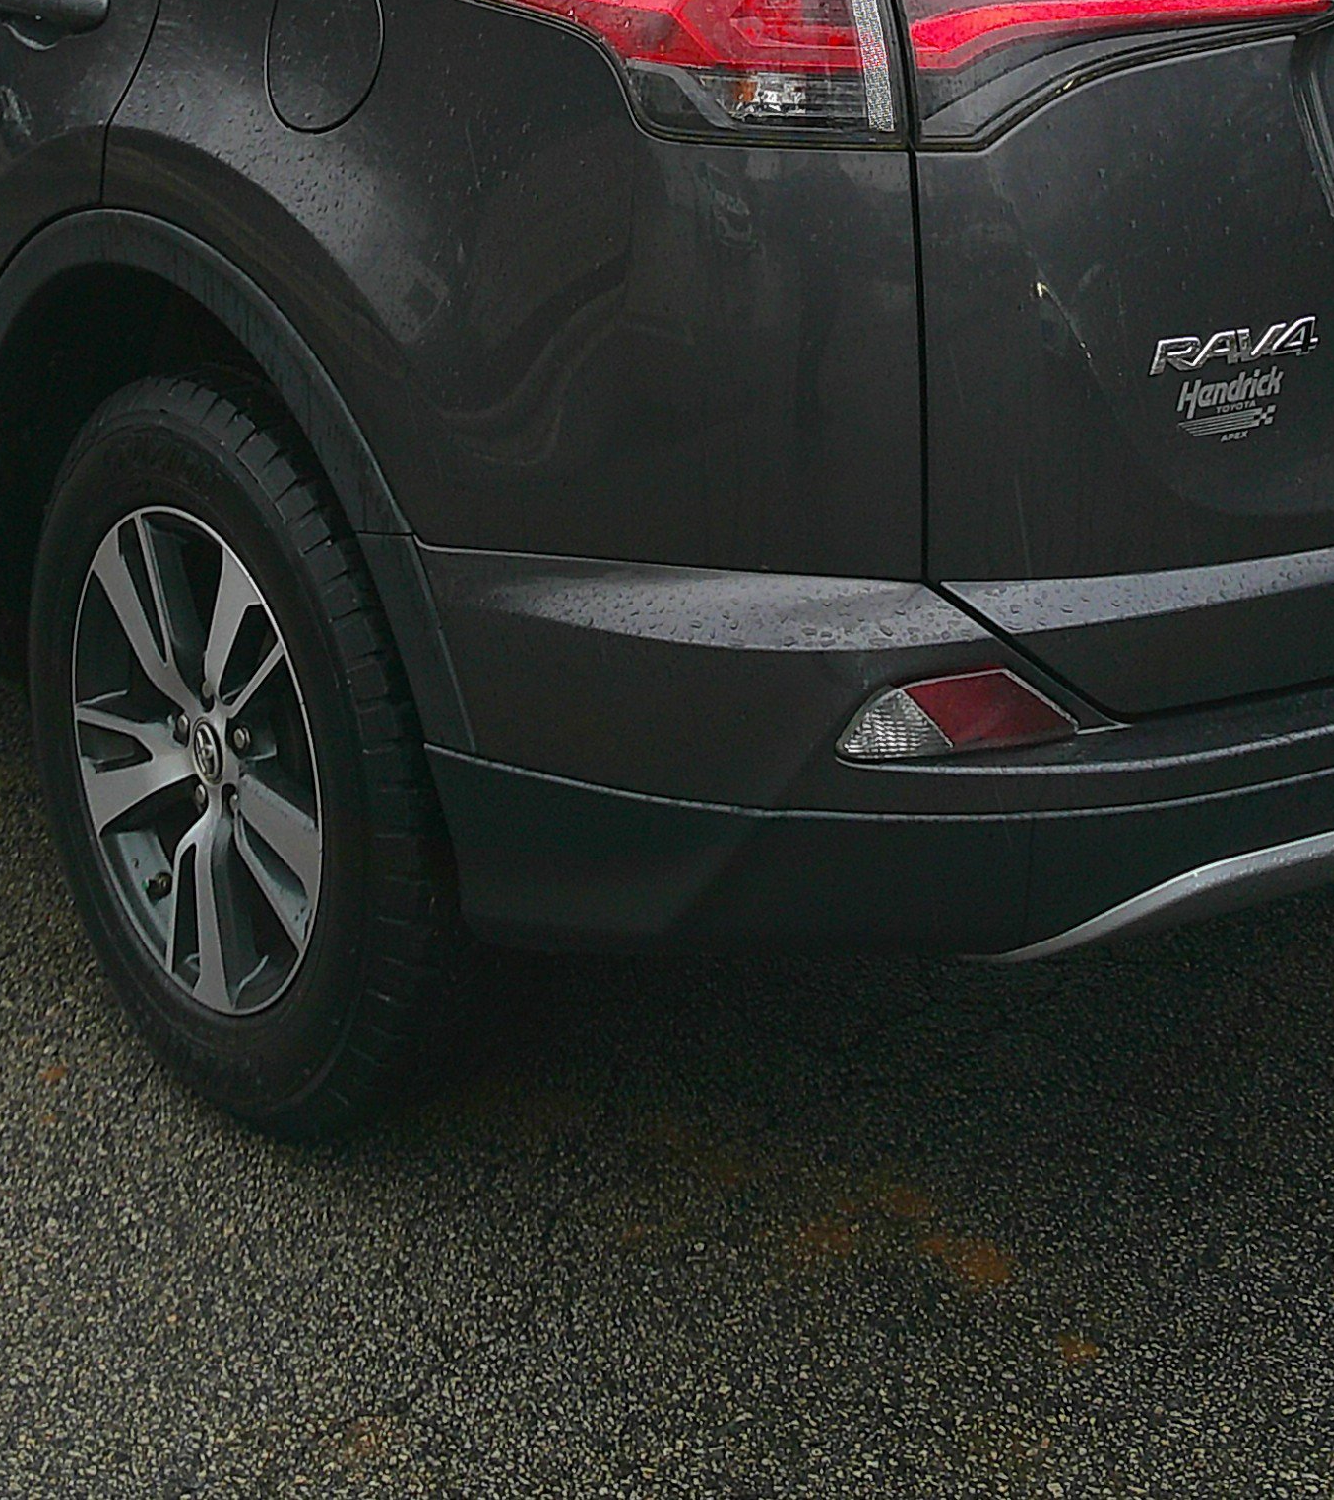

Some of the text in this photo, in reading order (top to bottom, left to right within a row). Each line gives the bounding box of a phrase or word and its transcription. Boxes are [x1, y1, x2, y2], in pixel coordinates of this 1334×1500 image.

[1149, 316, 1319, 376] RAV4
[1176, 366, 1285, 420] Hendrick
[1216, 400, 1257, 414] TOYOTA
[1221, 430, 1249, 443] APEX
